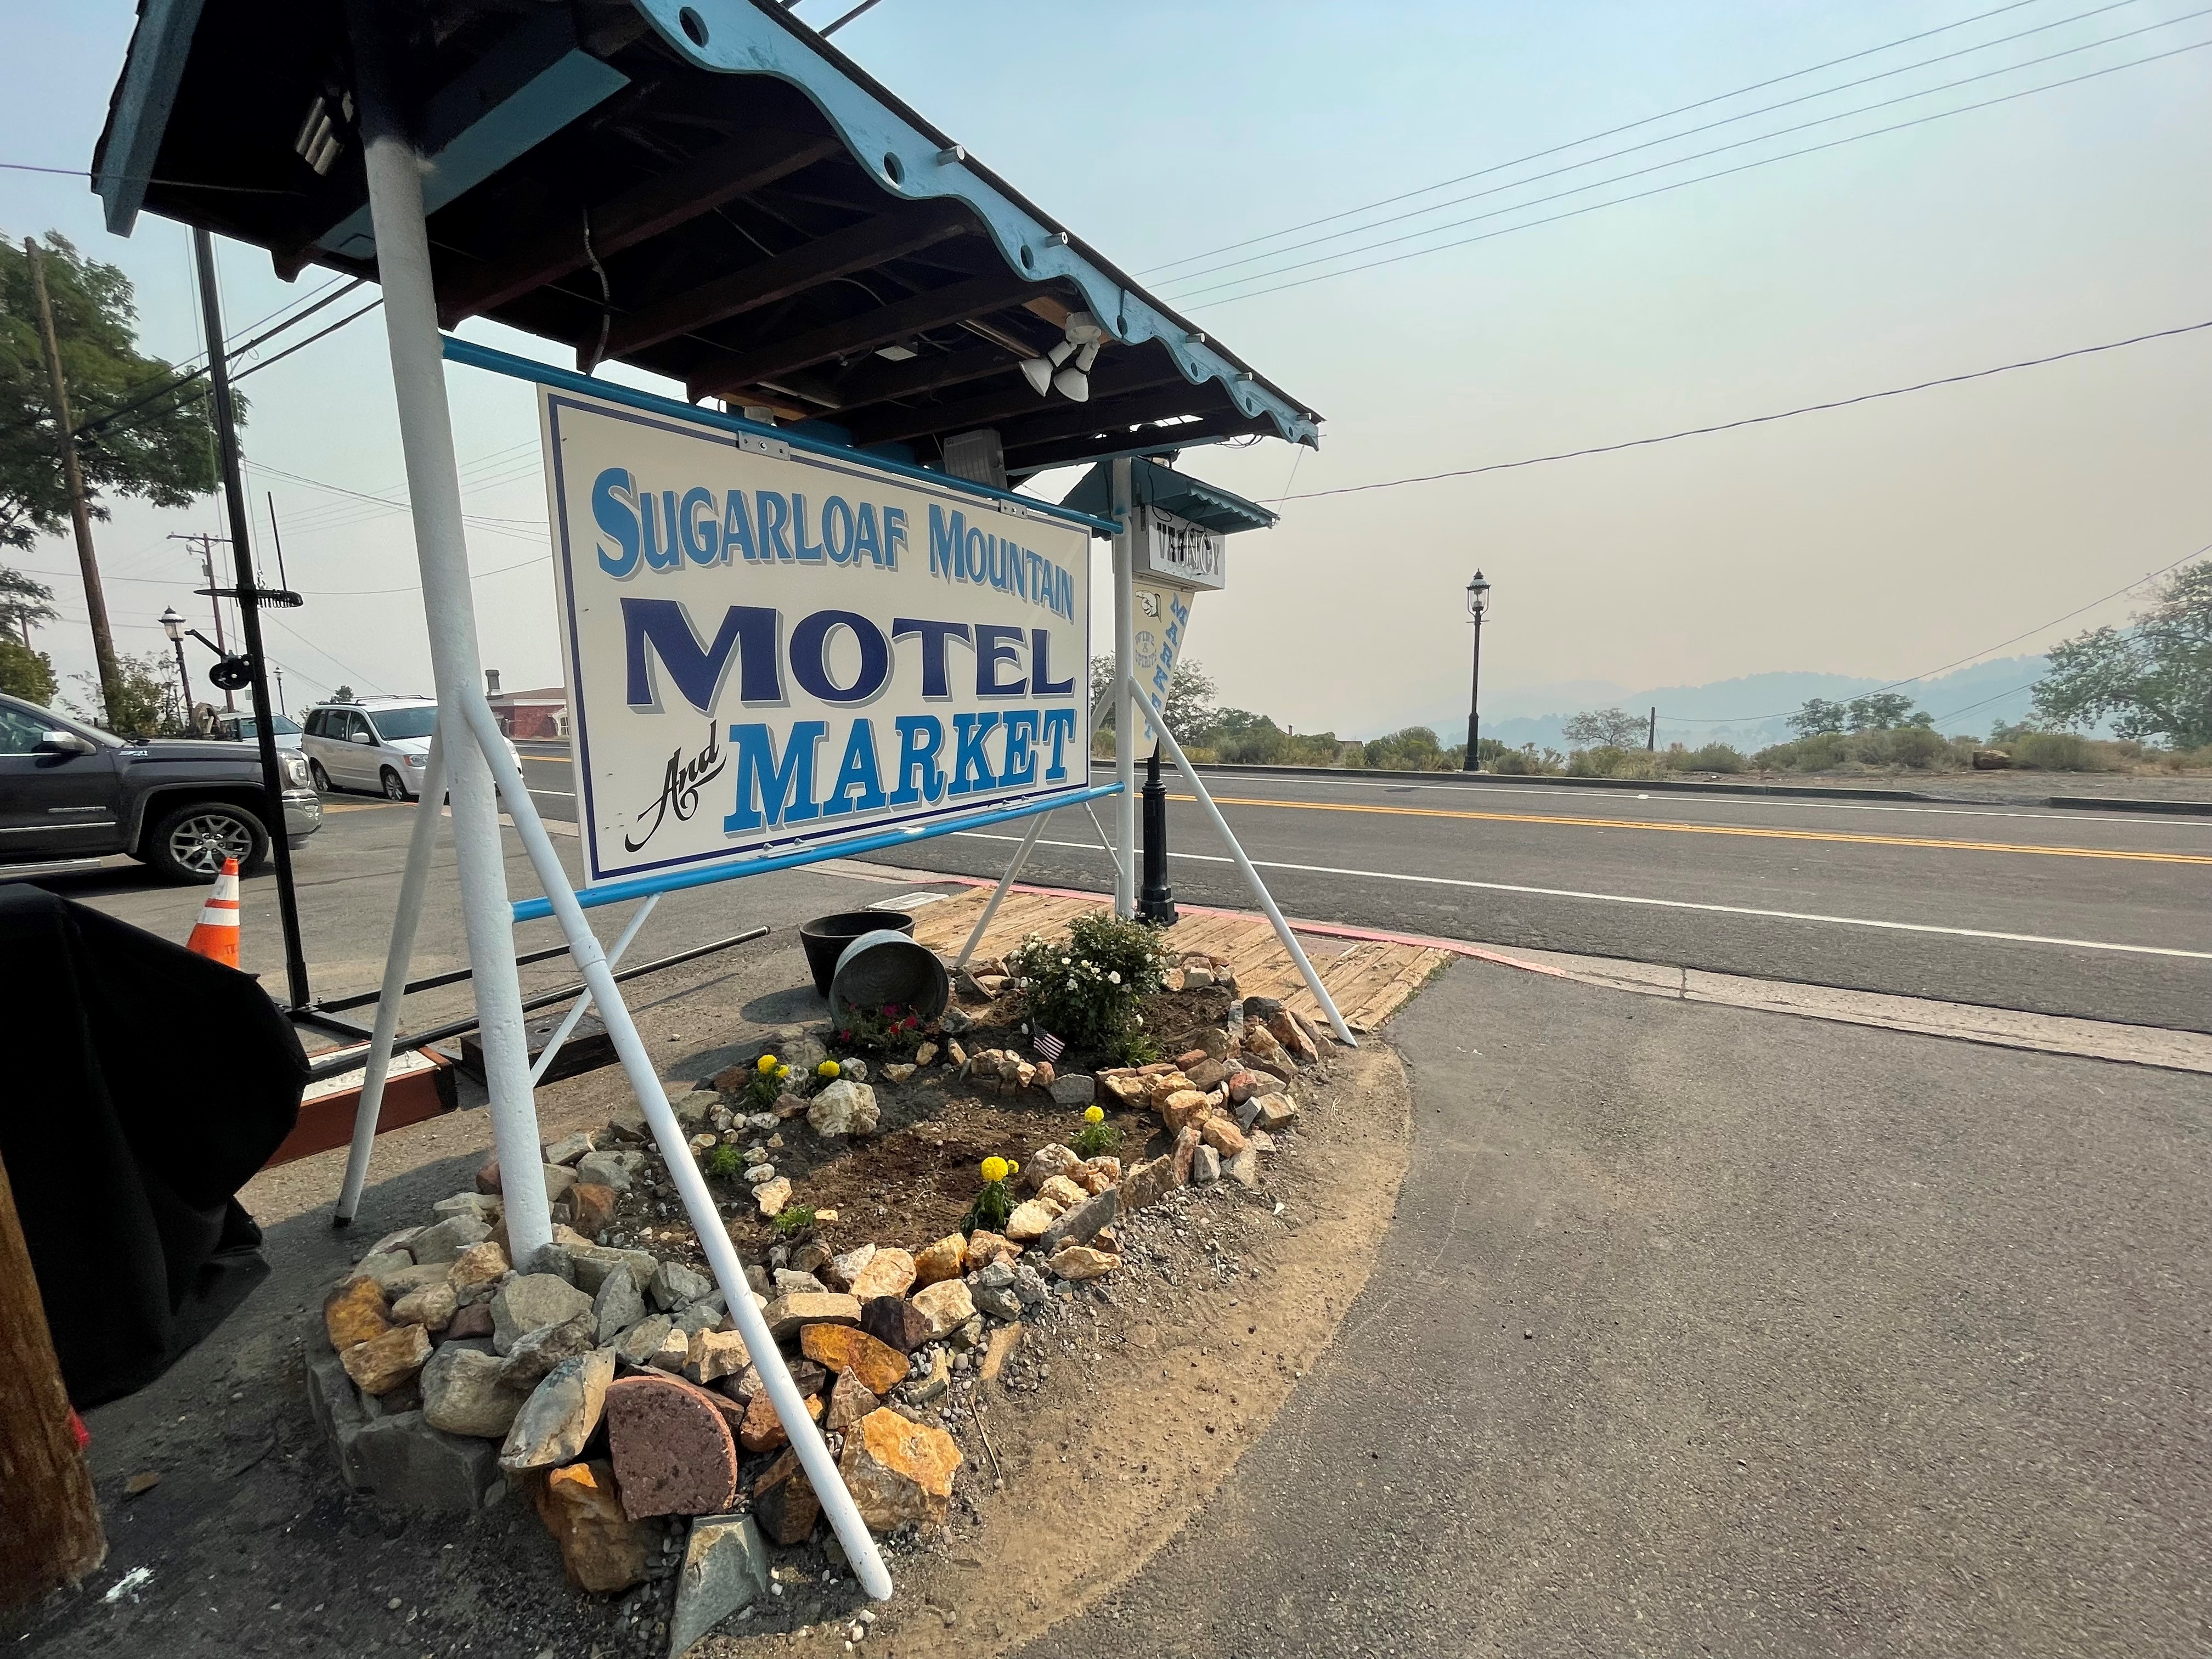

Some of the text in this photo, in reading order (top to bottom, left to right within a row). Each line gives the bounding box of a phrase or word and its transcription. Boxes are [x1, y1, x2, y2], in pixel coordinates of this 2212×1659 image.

[591, 467, 1074, 623] SUGARLOAF MOUNTAIN
[620, 597, 1077, 715] MOTEL
[625, 719, 727, 852] And
[724, 710, 1077, 837] MARKET
